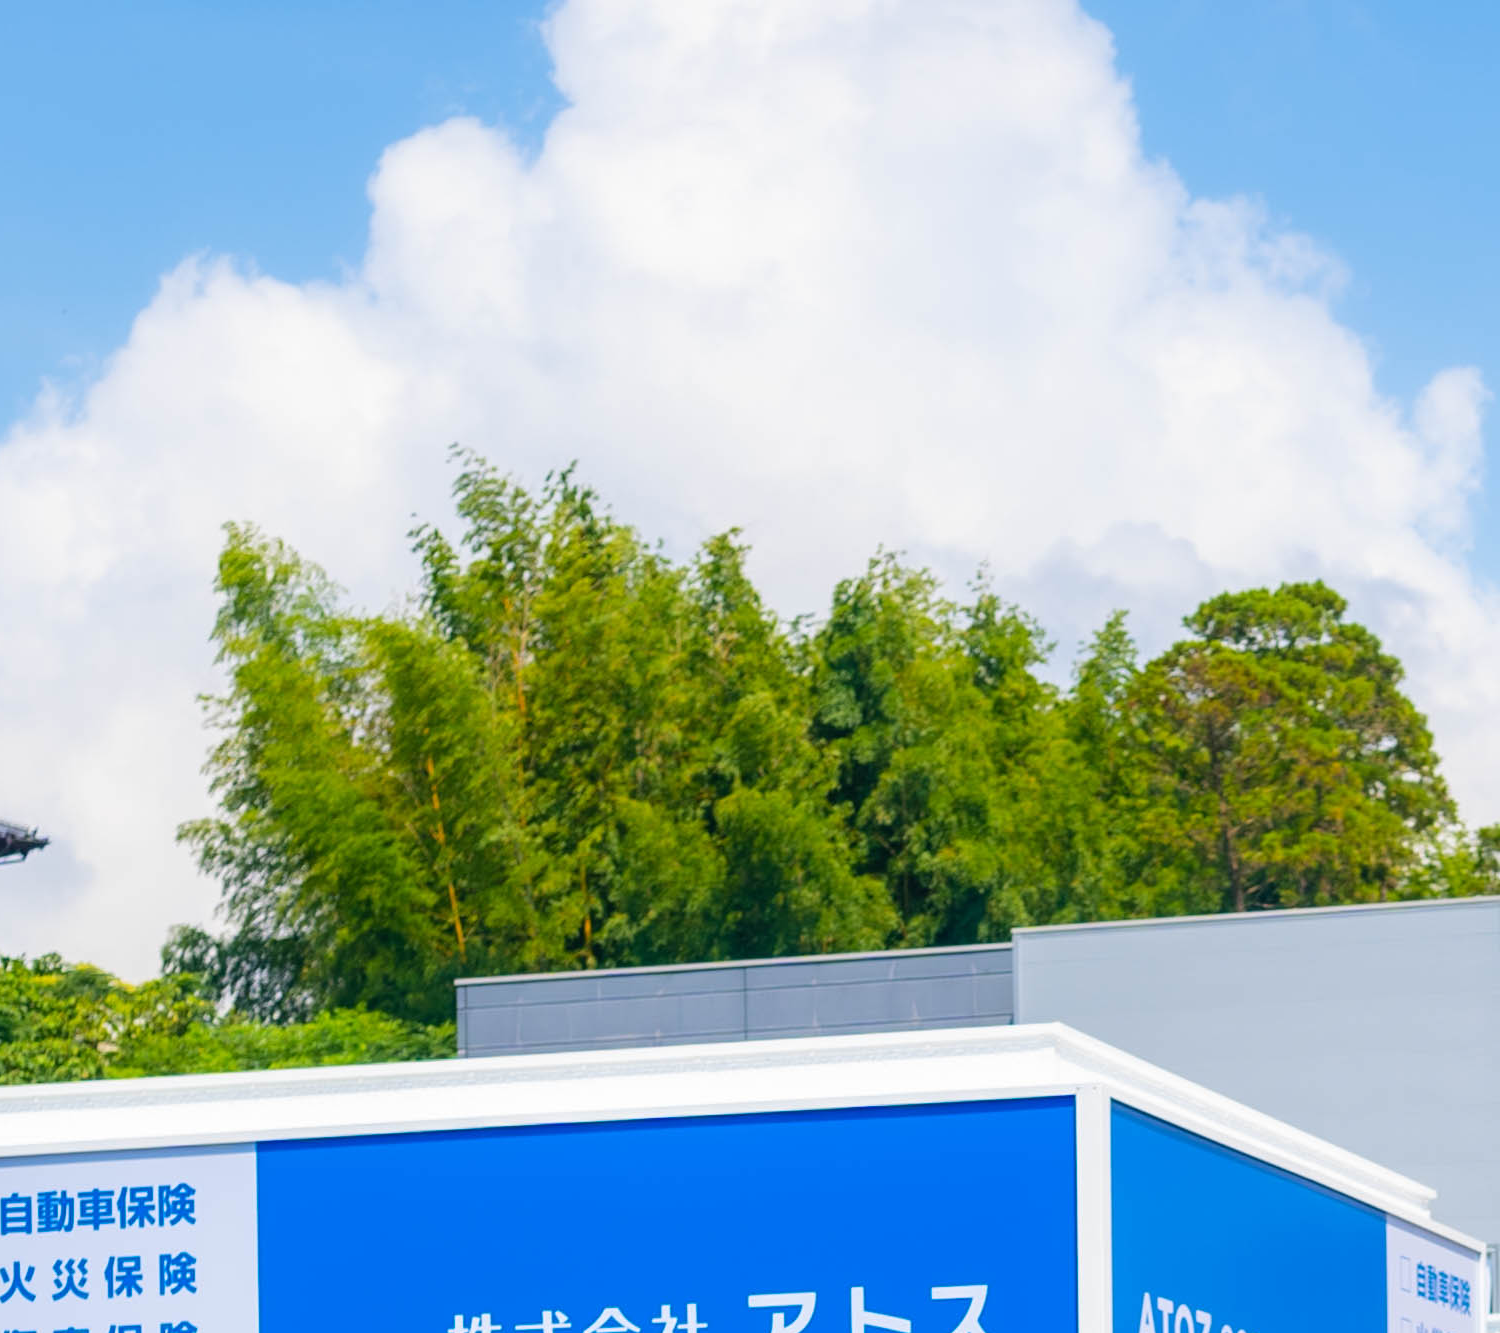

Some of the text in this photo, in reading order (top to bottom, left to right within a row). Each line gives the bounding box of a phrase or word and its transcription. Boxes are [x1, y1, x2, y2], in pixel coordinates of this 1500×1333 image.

[0, 1183, 196, 1235] 自動車保険
[0, 1252, 197, 1303] 火災保険
[1417, 1261, 1471, 1316] 自動車保険
